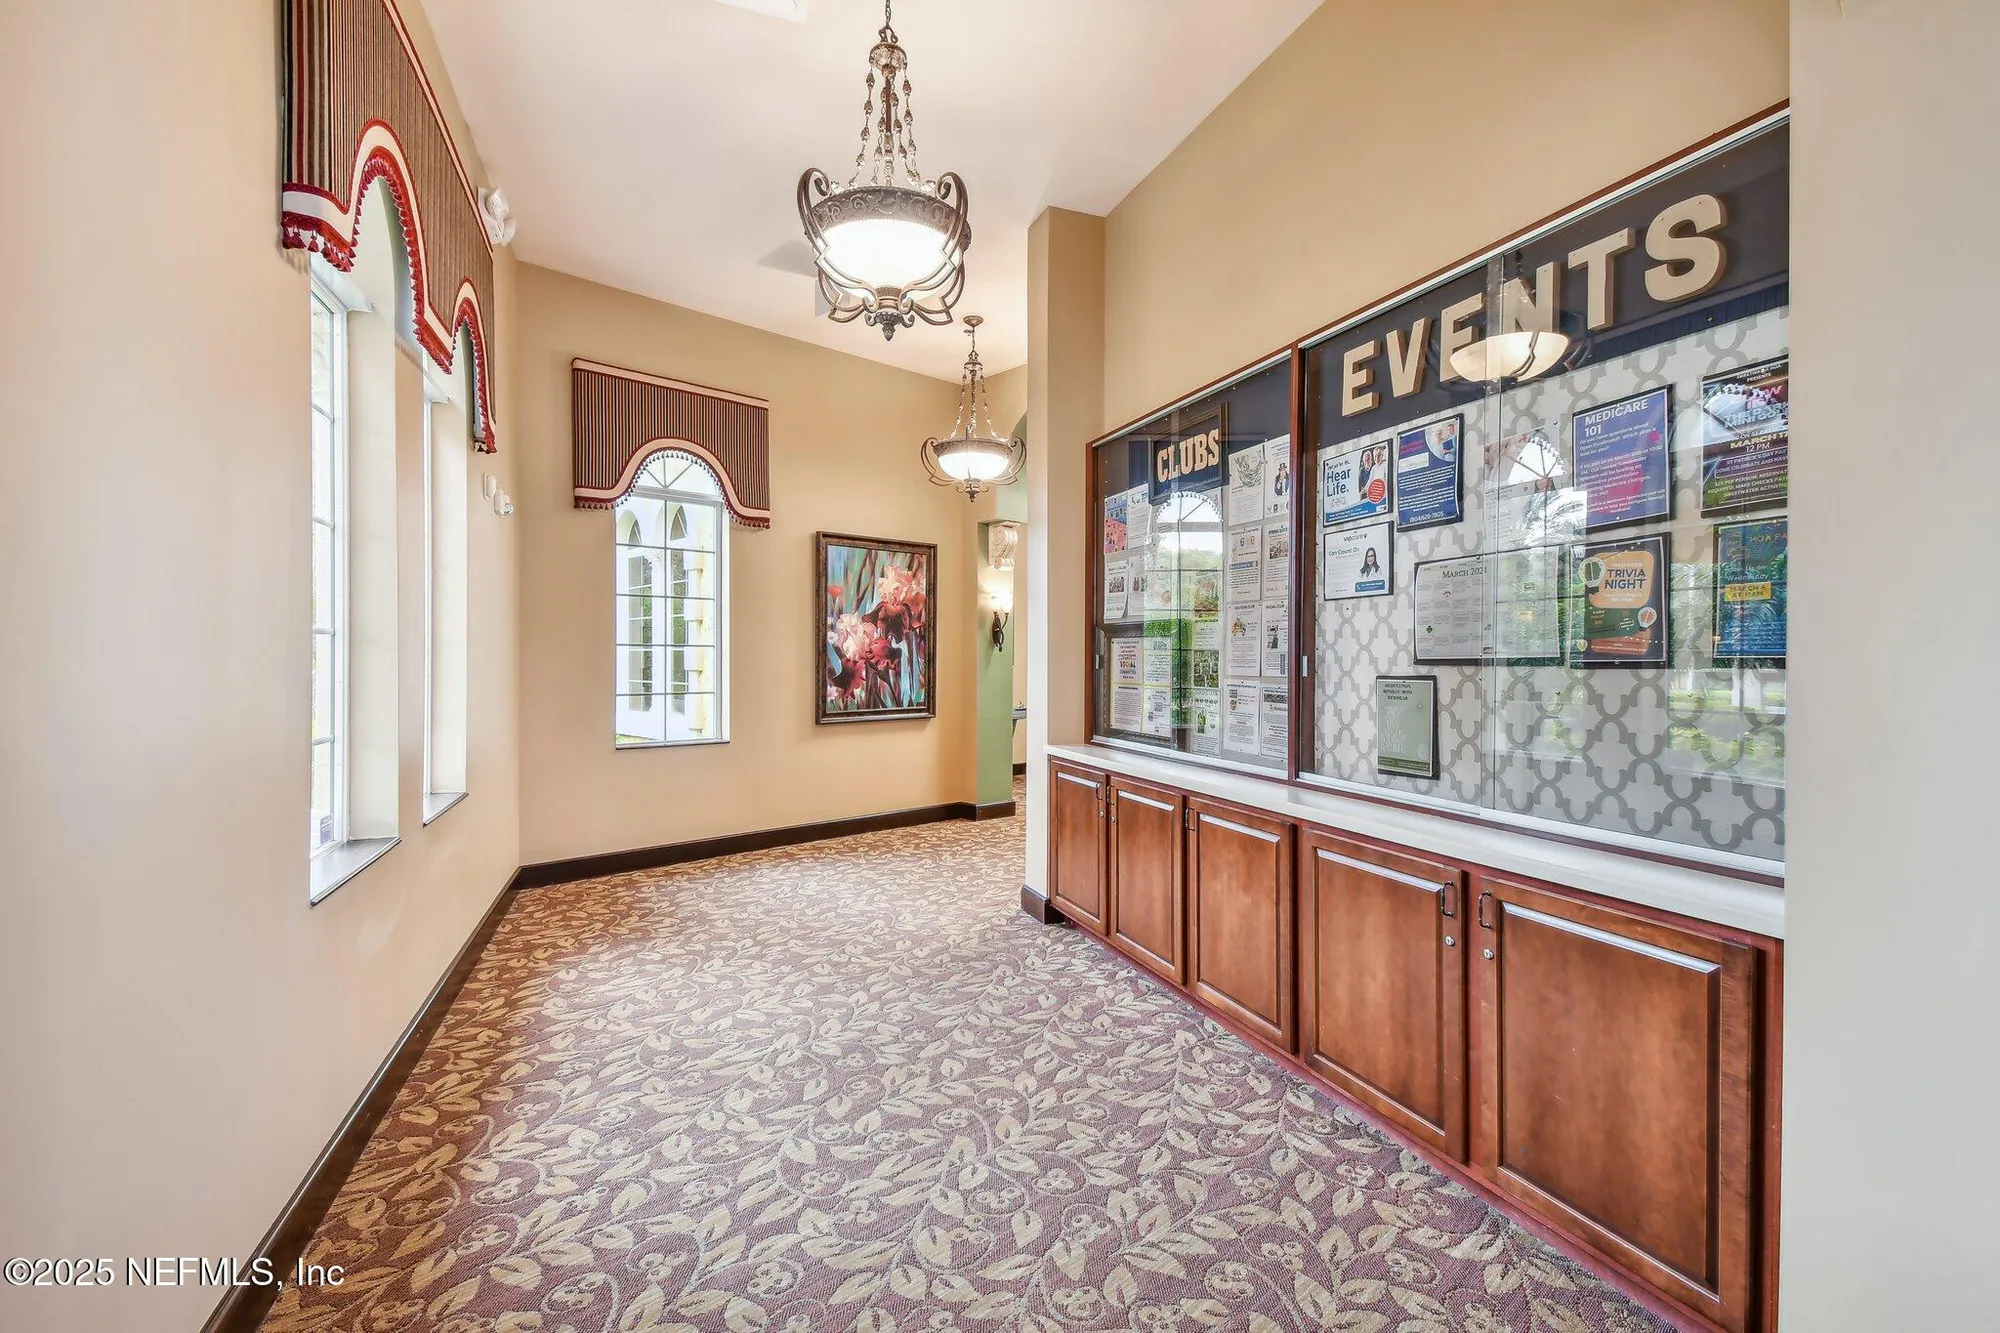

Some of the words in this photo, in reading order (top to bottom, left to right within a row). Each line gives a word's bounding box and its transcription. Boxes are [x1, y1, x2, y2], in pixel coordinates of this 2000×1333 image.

[1341, 193, 1728, 417] EVENTS
[1746, 372, 1771, 382] PRESENTS
[1585, 398, 1649, 426] MEDICARE
[1584, 424, 1602, 437] 101
[1730, 431, 1777, 449] MARCH
[1756, 442, 1770, 451] PM
[1157, 428, 1220, 483] CLUBS
[1327, 469, 1352, 484] Hear
[1751, 479, 1774, 487] CHECKS
[1327, 482, 1350, 498] Life.
[1607, 568, 1647, 578] TRIVIA
[1604, 578, 1647, 590] NIGHT
[1729, 585, 1759, 593] MARCH
